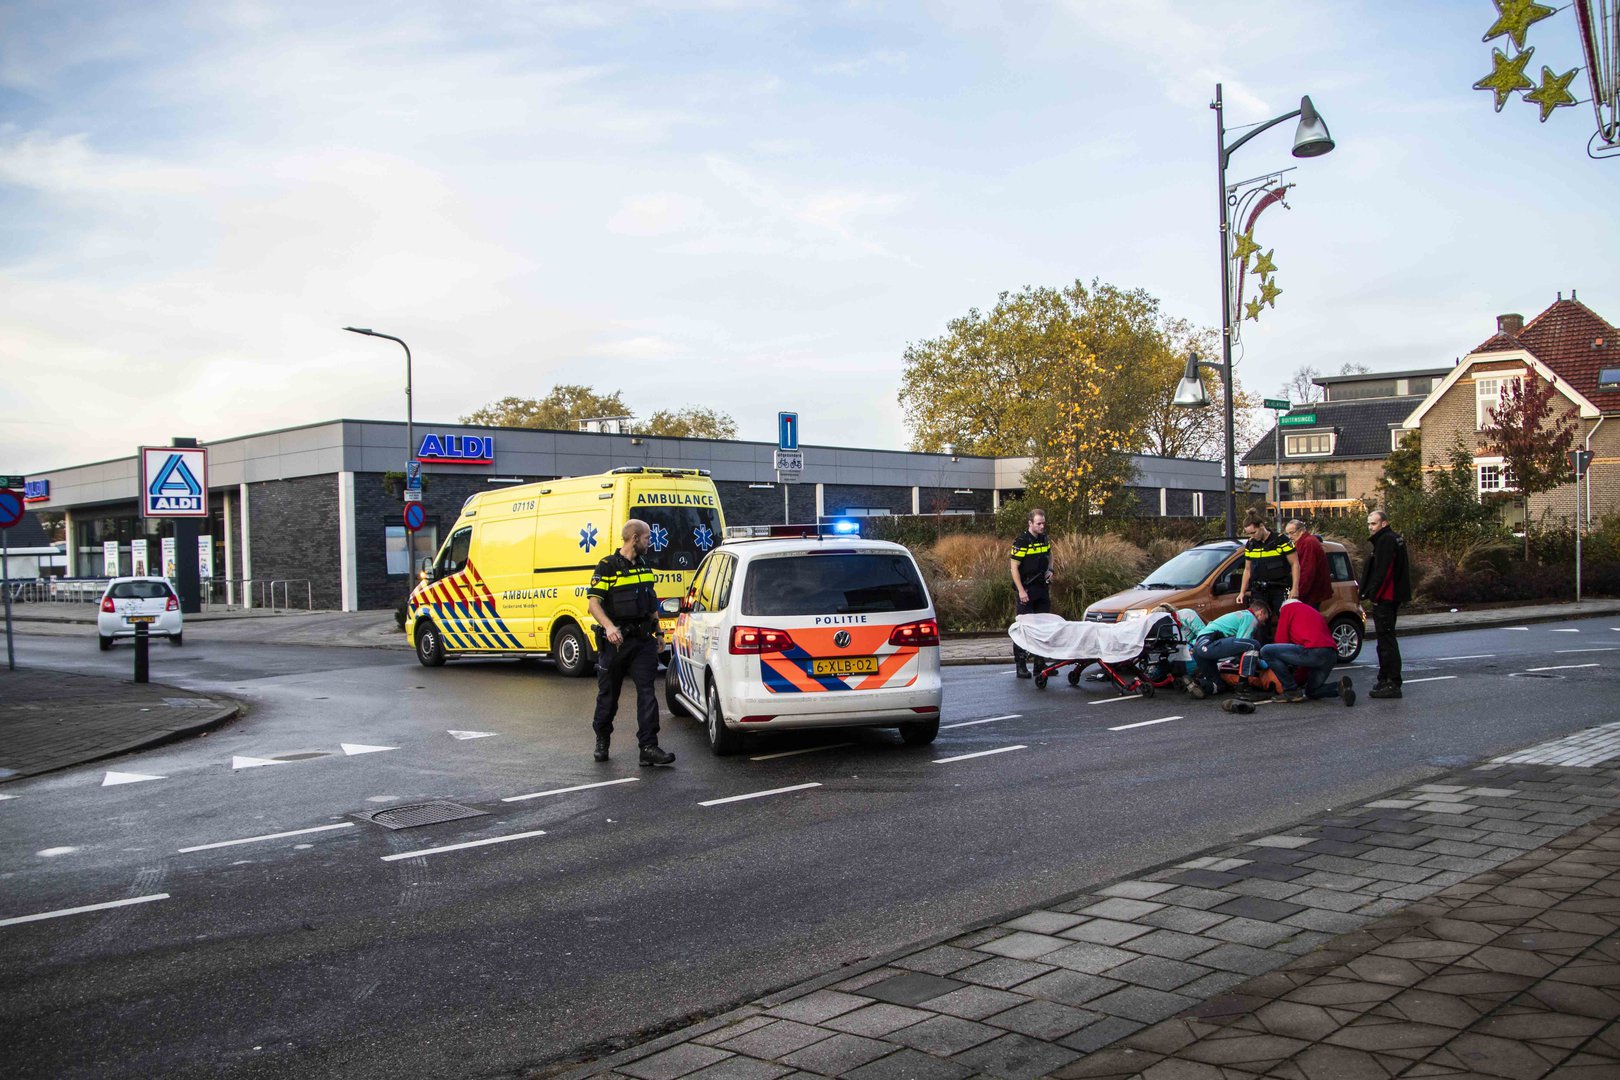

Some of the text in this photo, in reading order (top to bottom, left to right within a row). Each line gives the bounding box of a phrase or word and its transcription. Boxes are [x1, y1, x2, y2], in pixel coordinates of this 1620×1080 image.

[418, 434, 493, 458] ALDI
[155, 497, 198, 509] ALDI
[637, 493, 714, 505] AMBULANCE
[512, 500, 535, 512] 07118
[654, 573, 682, 583] 07118
[503, 588, 558, 600] AMBULANCE
[815, 615, 867, 625] POLITIE
[816, 659, 873, 673] 6-XLB-02
